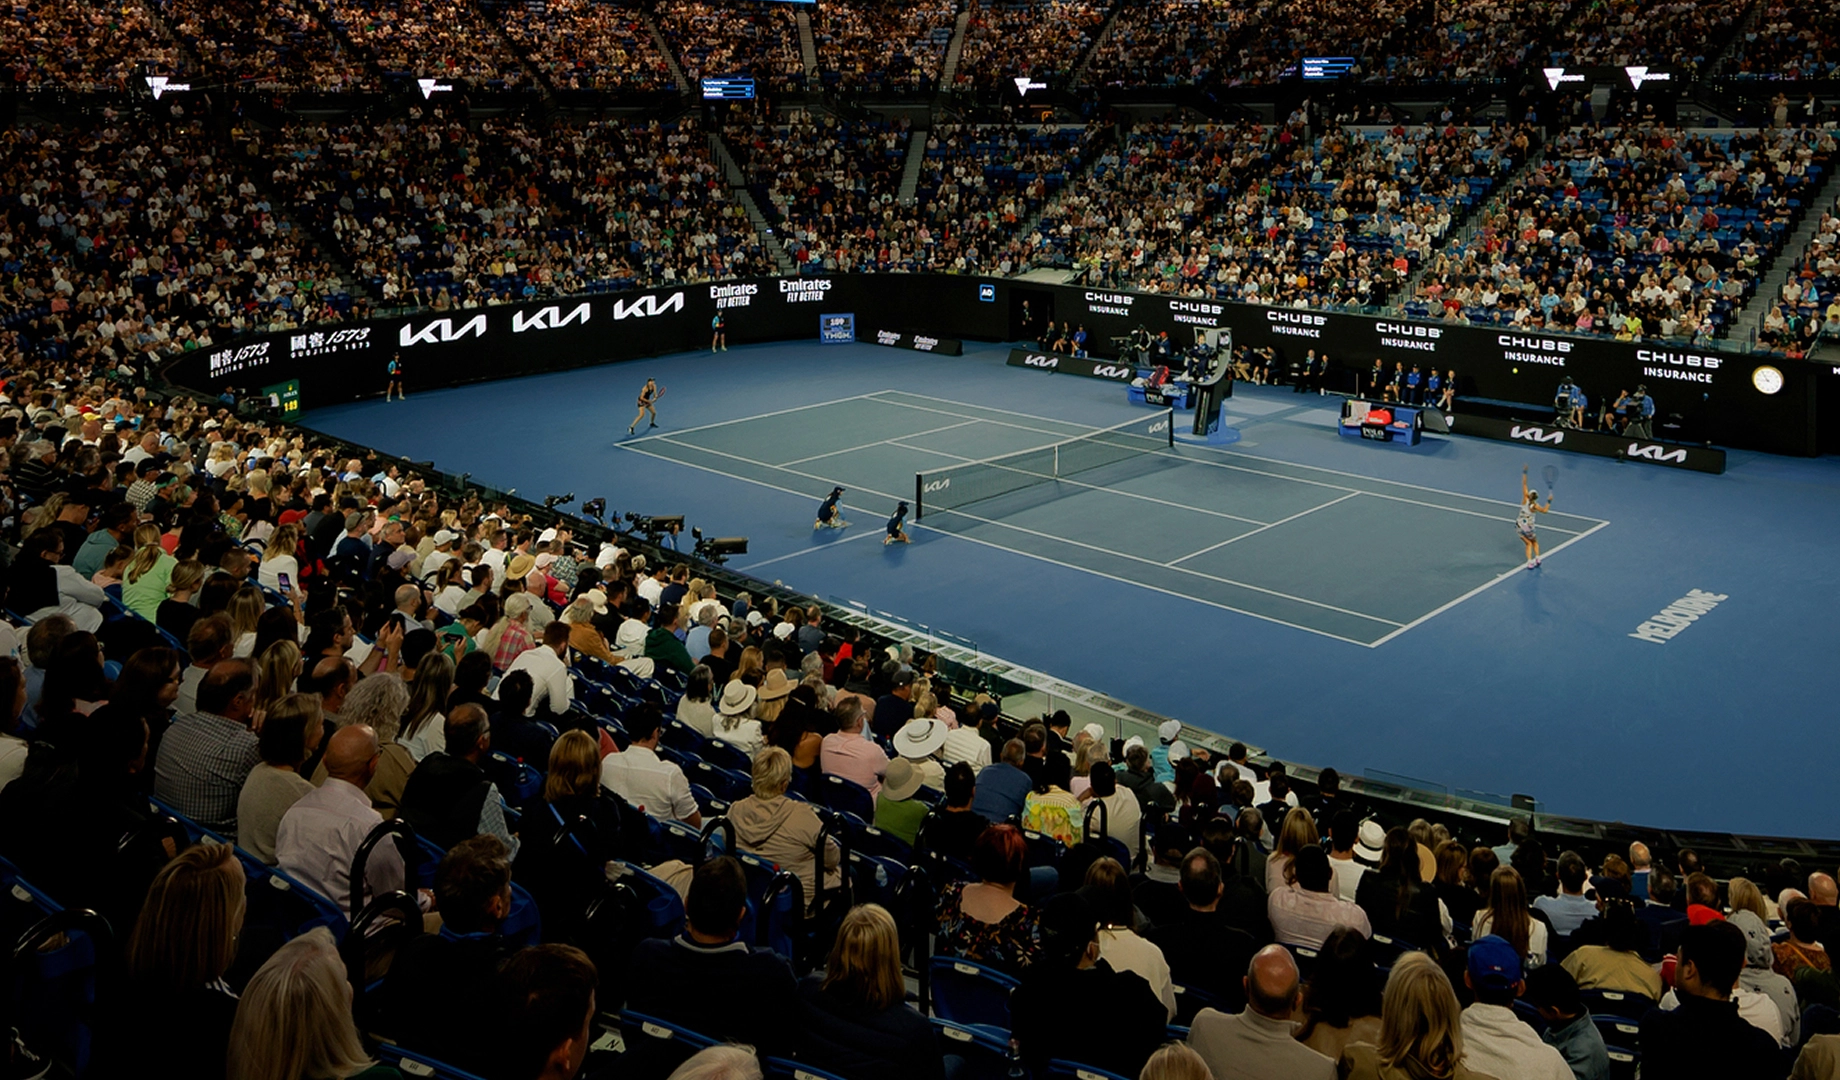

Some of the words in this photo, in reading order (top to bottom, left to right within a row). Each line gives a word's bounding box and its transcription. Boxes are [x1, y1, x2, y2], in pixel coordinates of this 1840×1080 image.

[710, 283, 758, 299] Emirates
[779, 279, 832, 293] Emirates
[717, 297, 727, 309] FLY
[727, 296, 750, 308] BETTER
[787, 292, 798, 303] FLY
[799, 290, 824, 302] BETTER
[1085, 292, 1132, 305] CHUBB
[613, 292, 684, 320] KIA
[1089, 304, 1129, 317] INSURANCE
[1170, 300, 1222, 314] CHUBB
[512, 302, 591, 333] KIA
[1174, 314, 1217, 327] INSURANCE
[1267, 311, 1326, 326] CHUBB
[399, 314, 486, 346] KIA
[1272, 325, 1320, 338] INSURANCE
[1376, 322, 1440, 339] CHUBB
[290, 346, 337, 358] GUOJIAO
[345, 341, 370, 351] 1573
[1381, 337, 1435, 351] INSURANCE
[1498, 335, 1572, 353] CHUBB
[1025, 354, 1058, 368] KIA
[1504, 351, 1565, 366] INSURANCE
[1637, 349, 1720, 369] CHUBB
[210, 363, 243, 378] GUOJIAO
[248, 357, 270, 368] 1573
[1093, 364, 1129, 379] KIA
[1644, 366, 1712, 383] INSURANCE
[1510, 424, 1564, 445] KIA
[1627, 442, 1687, 463] KIA
[1627, 588, 1729, 645] MELBOURNE
